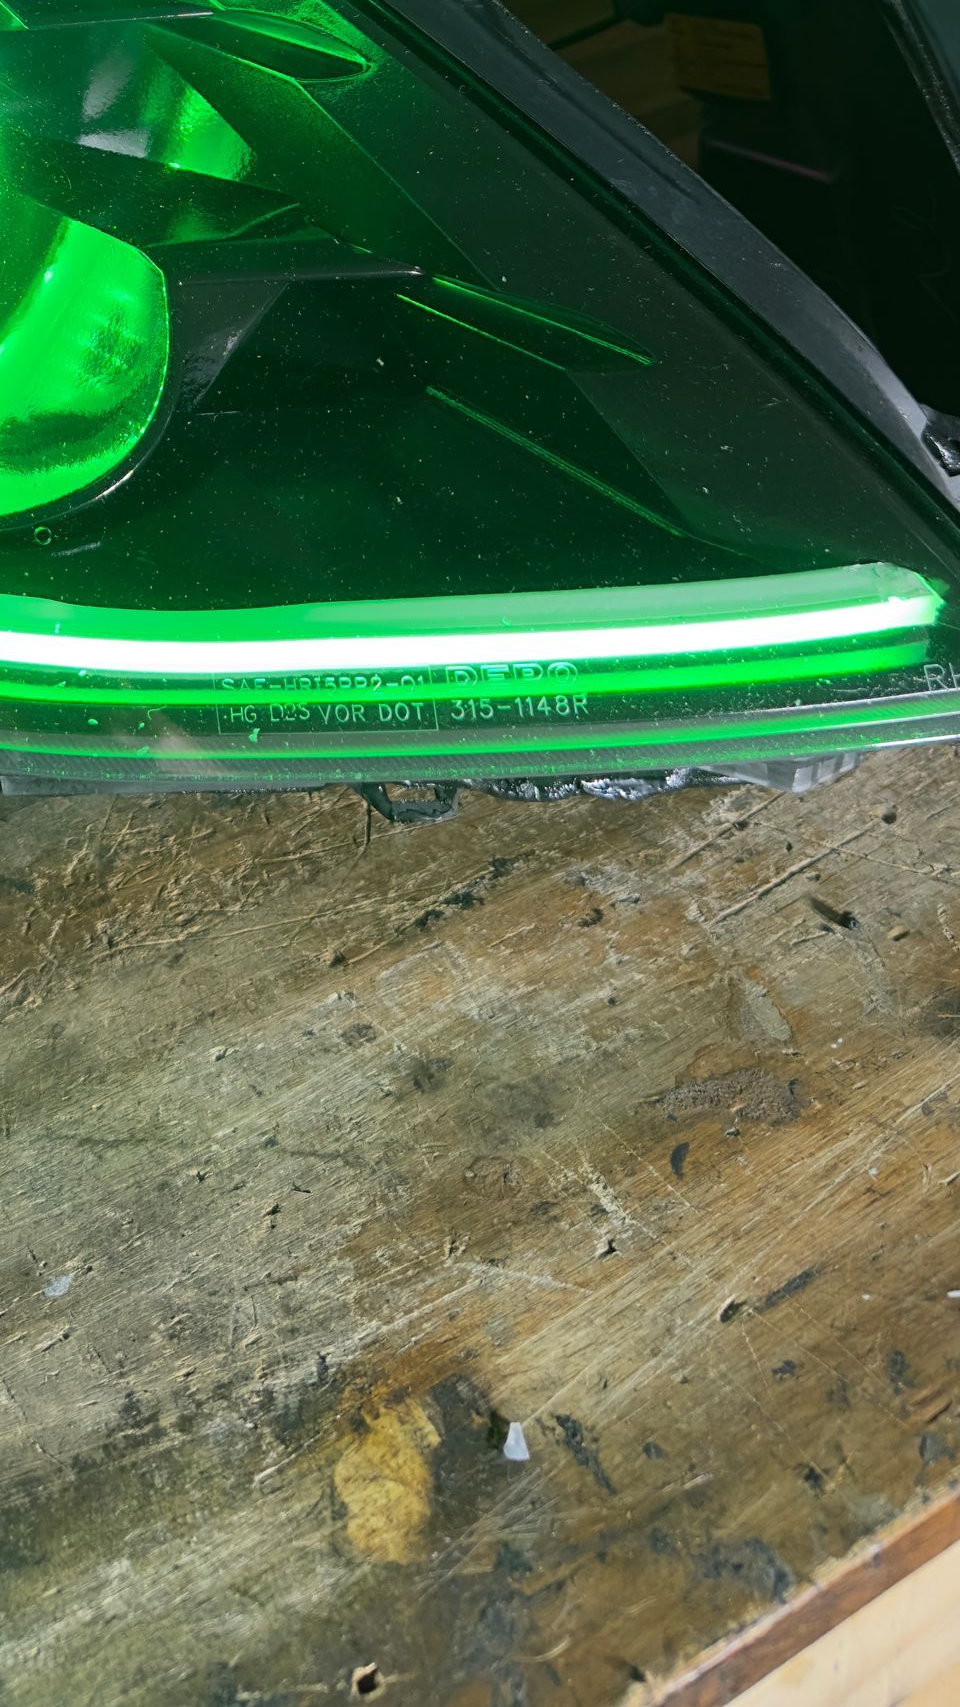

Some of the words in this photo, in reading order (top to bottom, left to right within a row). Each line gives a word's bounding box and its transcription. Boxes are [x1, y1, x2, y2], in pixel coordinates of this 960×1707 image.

[445, 661, 578, 688] DEPO
[230, 705, 257, 723] HG
[319, 703, 366, 724] VOR
[378, 701, 424, 722] DOT
[450, 694, 590, 720] 315-1148R
